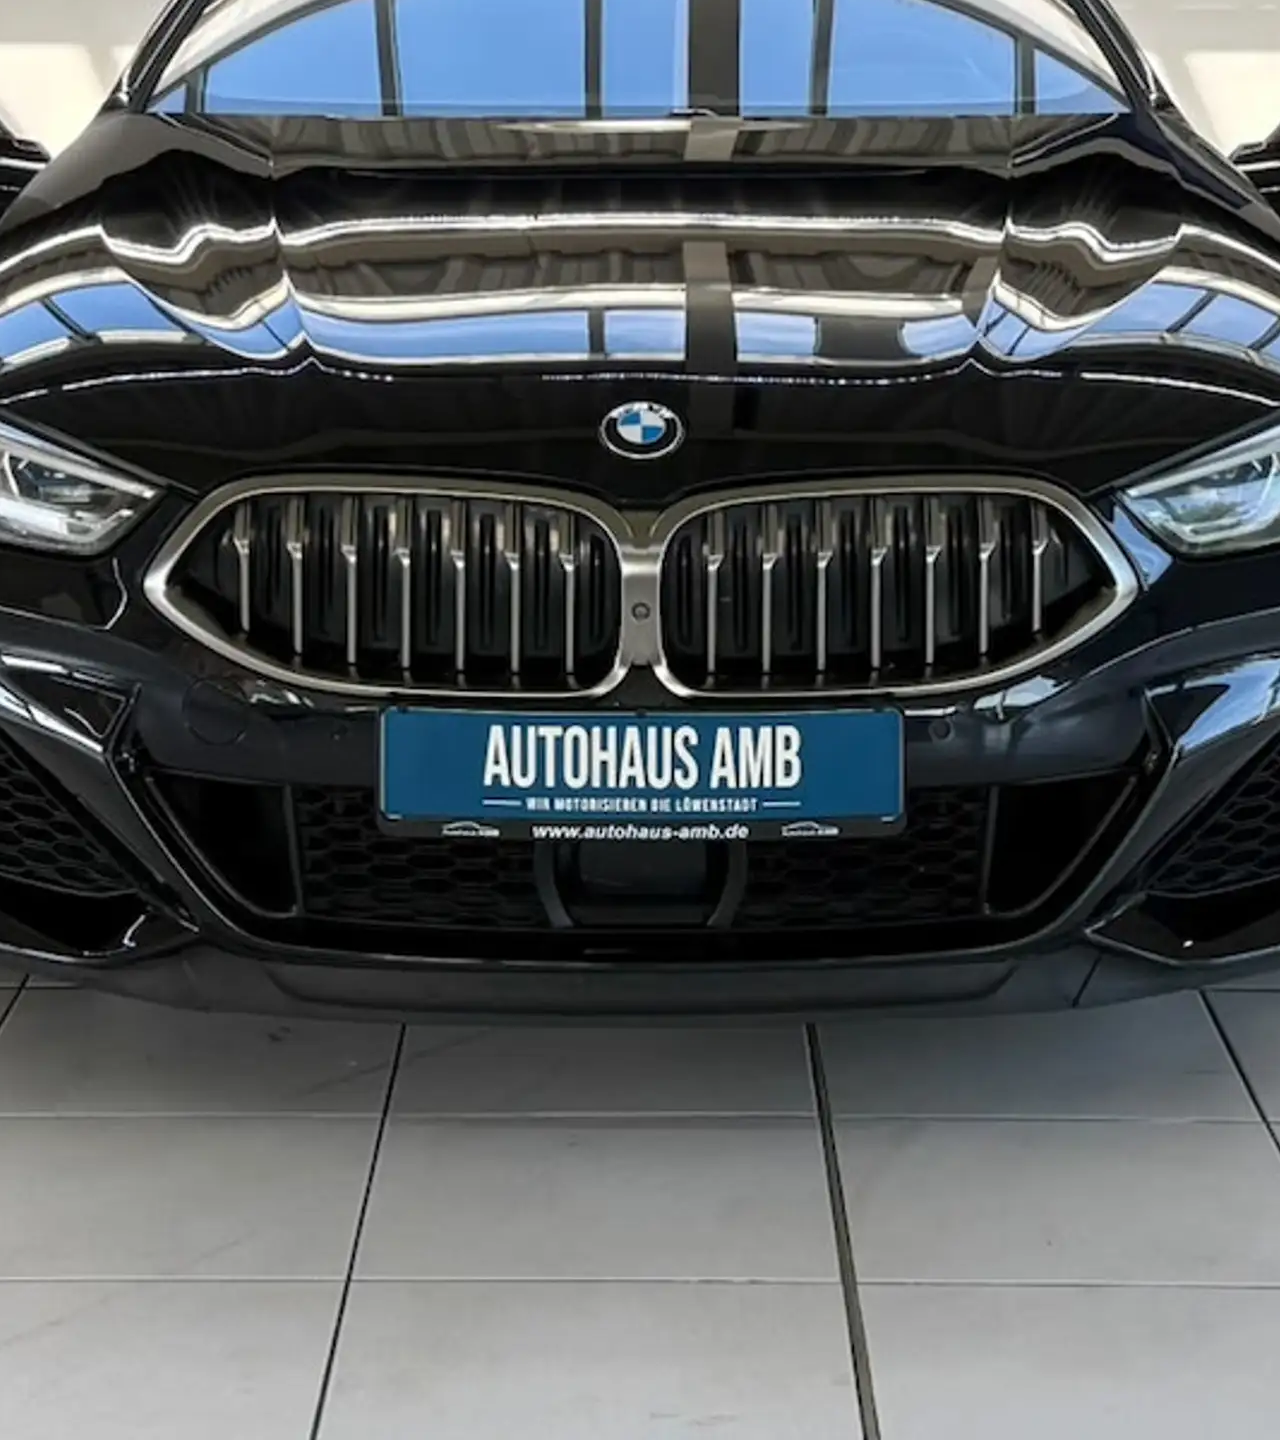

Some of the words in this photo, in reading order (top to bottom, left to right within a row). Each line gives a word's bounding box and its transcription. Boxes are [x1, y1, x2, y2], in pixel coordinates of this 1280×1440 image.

[483, 723, 699, 791] AUTOHAUS
[709, 724, 803, 790] AMB
[525, 796, 551, 812] WIR
[553, 796, 648, 814] MOTORISIEREN
[650, 797, 672, 813] DIE
[674, 796, 759, 814] LÖWENSTADT
[532, 823, 750, 841] www.autohaus-amb.de
